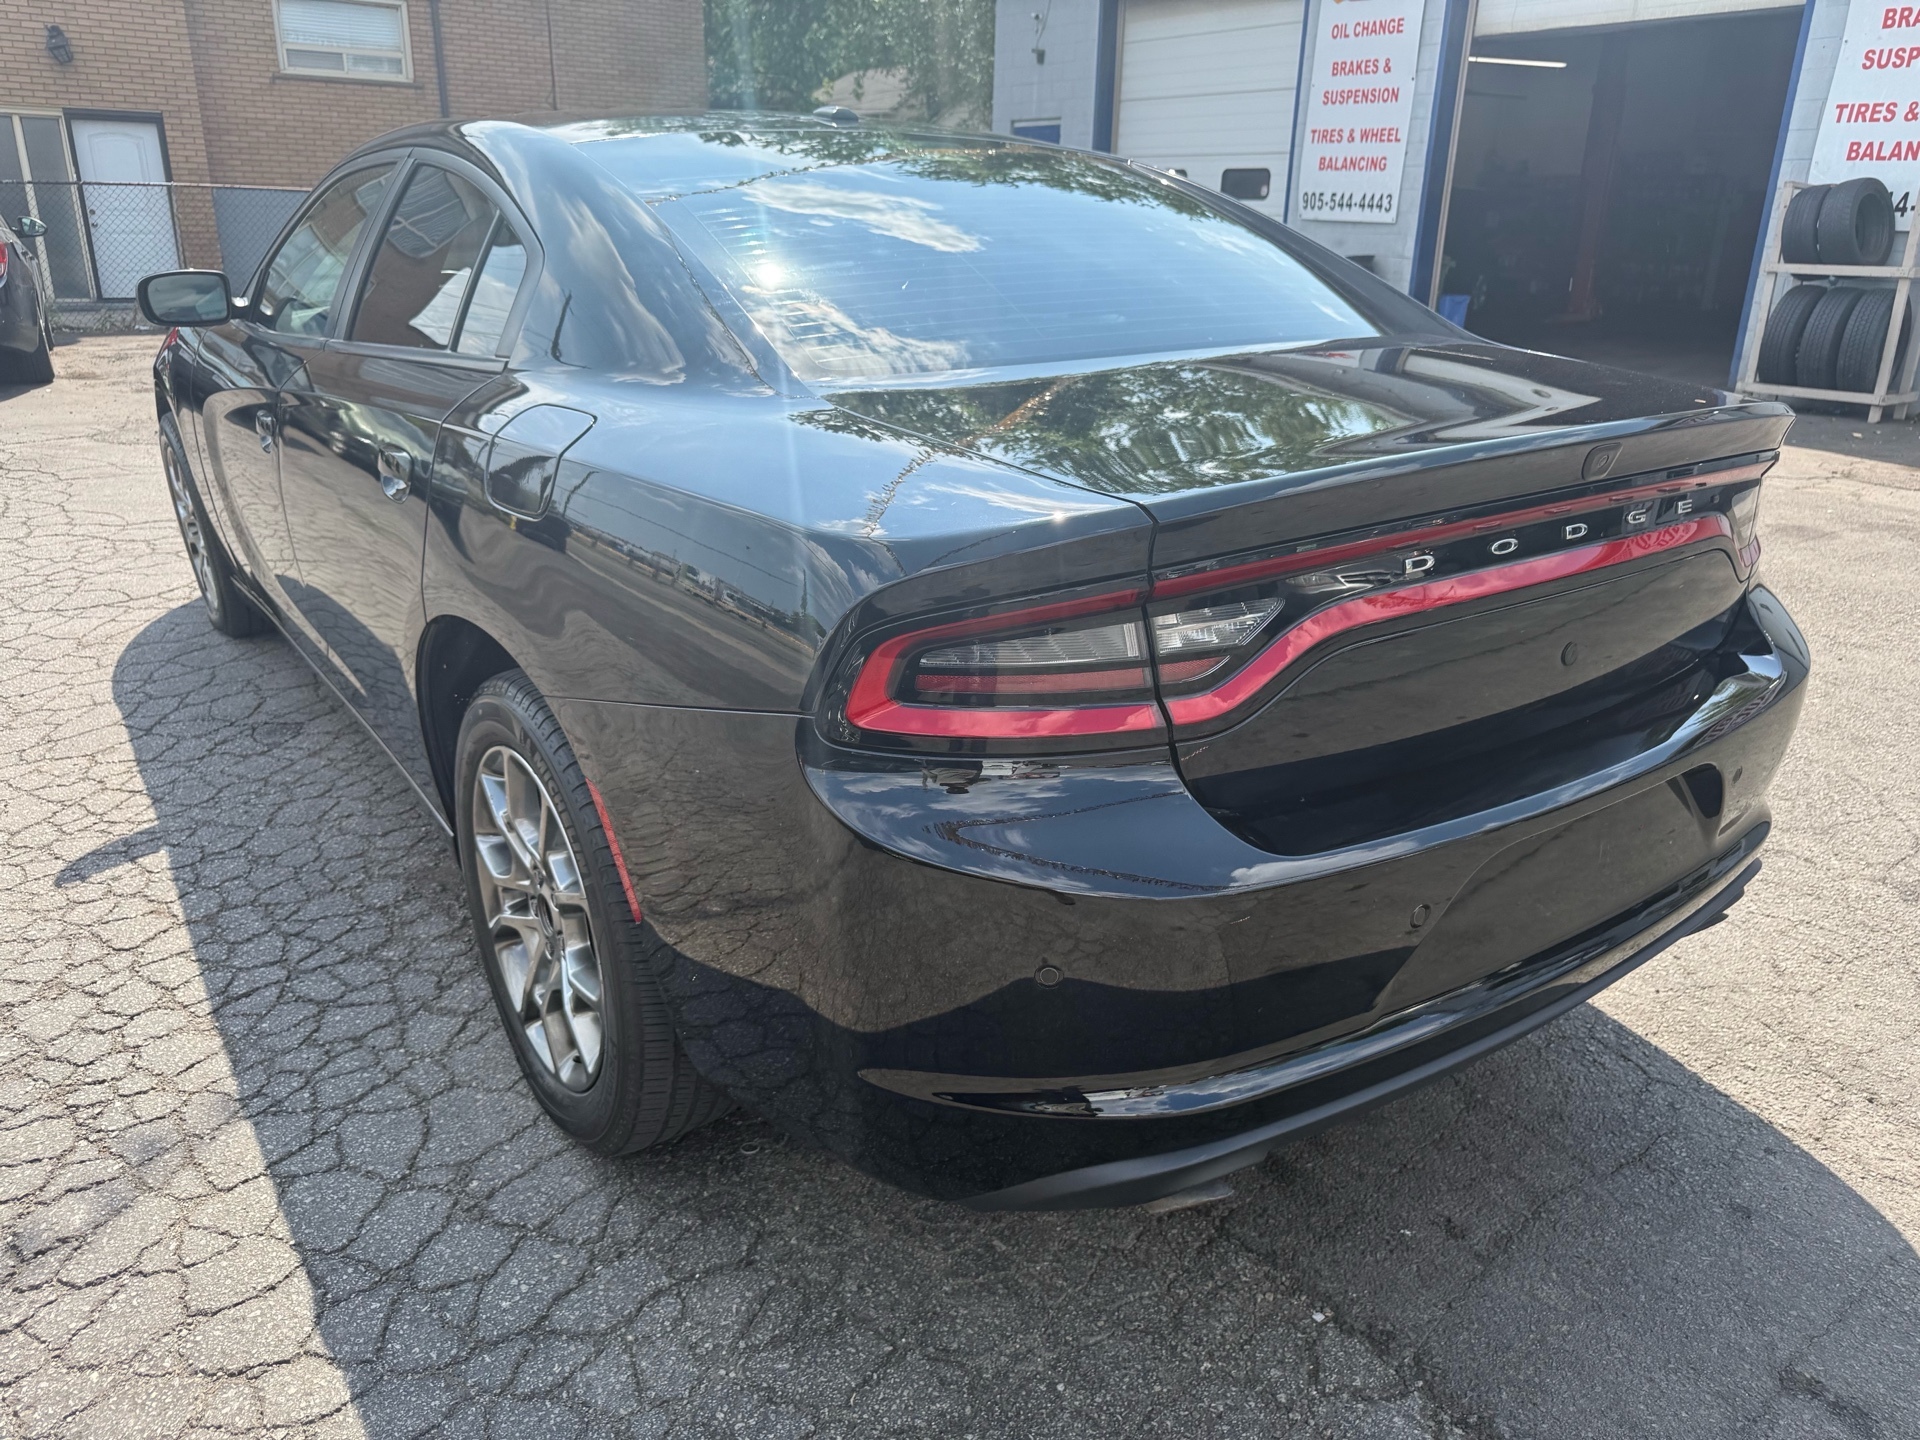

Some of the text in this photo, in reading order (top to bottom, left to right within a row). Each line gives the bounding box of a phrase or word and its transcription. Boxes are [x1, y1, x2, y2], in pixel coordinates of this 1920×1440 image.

[1331, 17, 1405, 39] OIL CHANGE
[1332, 58, 1392, 76] BRAKES &
[1861, 47, 1920, 70] SUSP
[1322, 87, 1400, 106] SUSPENSION
[1836, 101, 1919, 123] TIRES &
[1311, 127, 1401, 144] TIRES & WHEEL
[1846, 141, 1920, 161] BALAN
[1318, 156, 1387, 172] BALANCING
[1302, 192, 1393, 213] 905-544-4443
[1403, 499, 1693, 574] DODGE
[533, 751, 590, 874] MICHELIN
